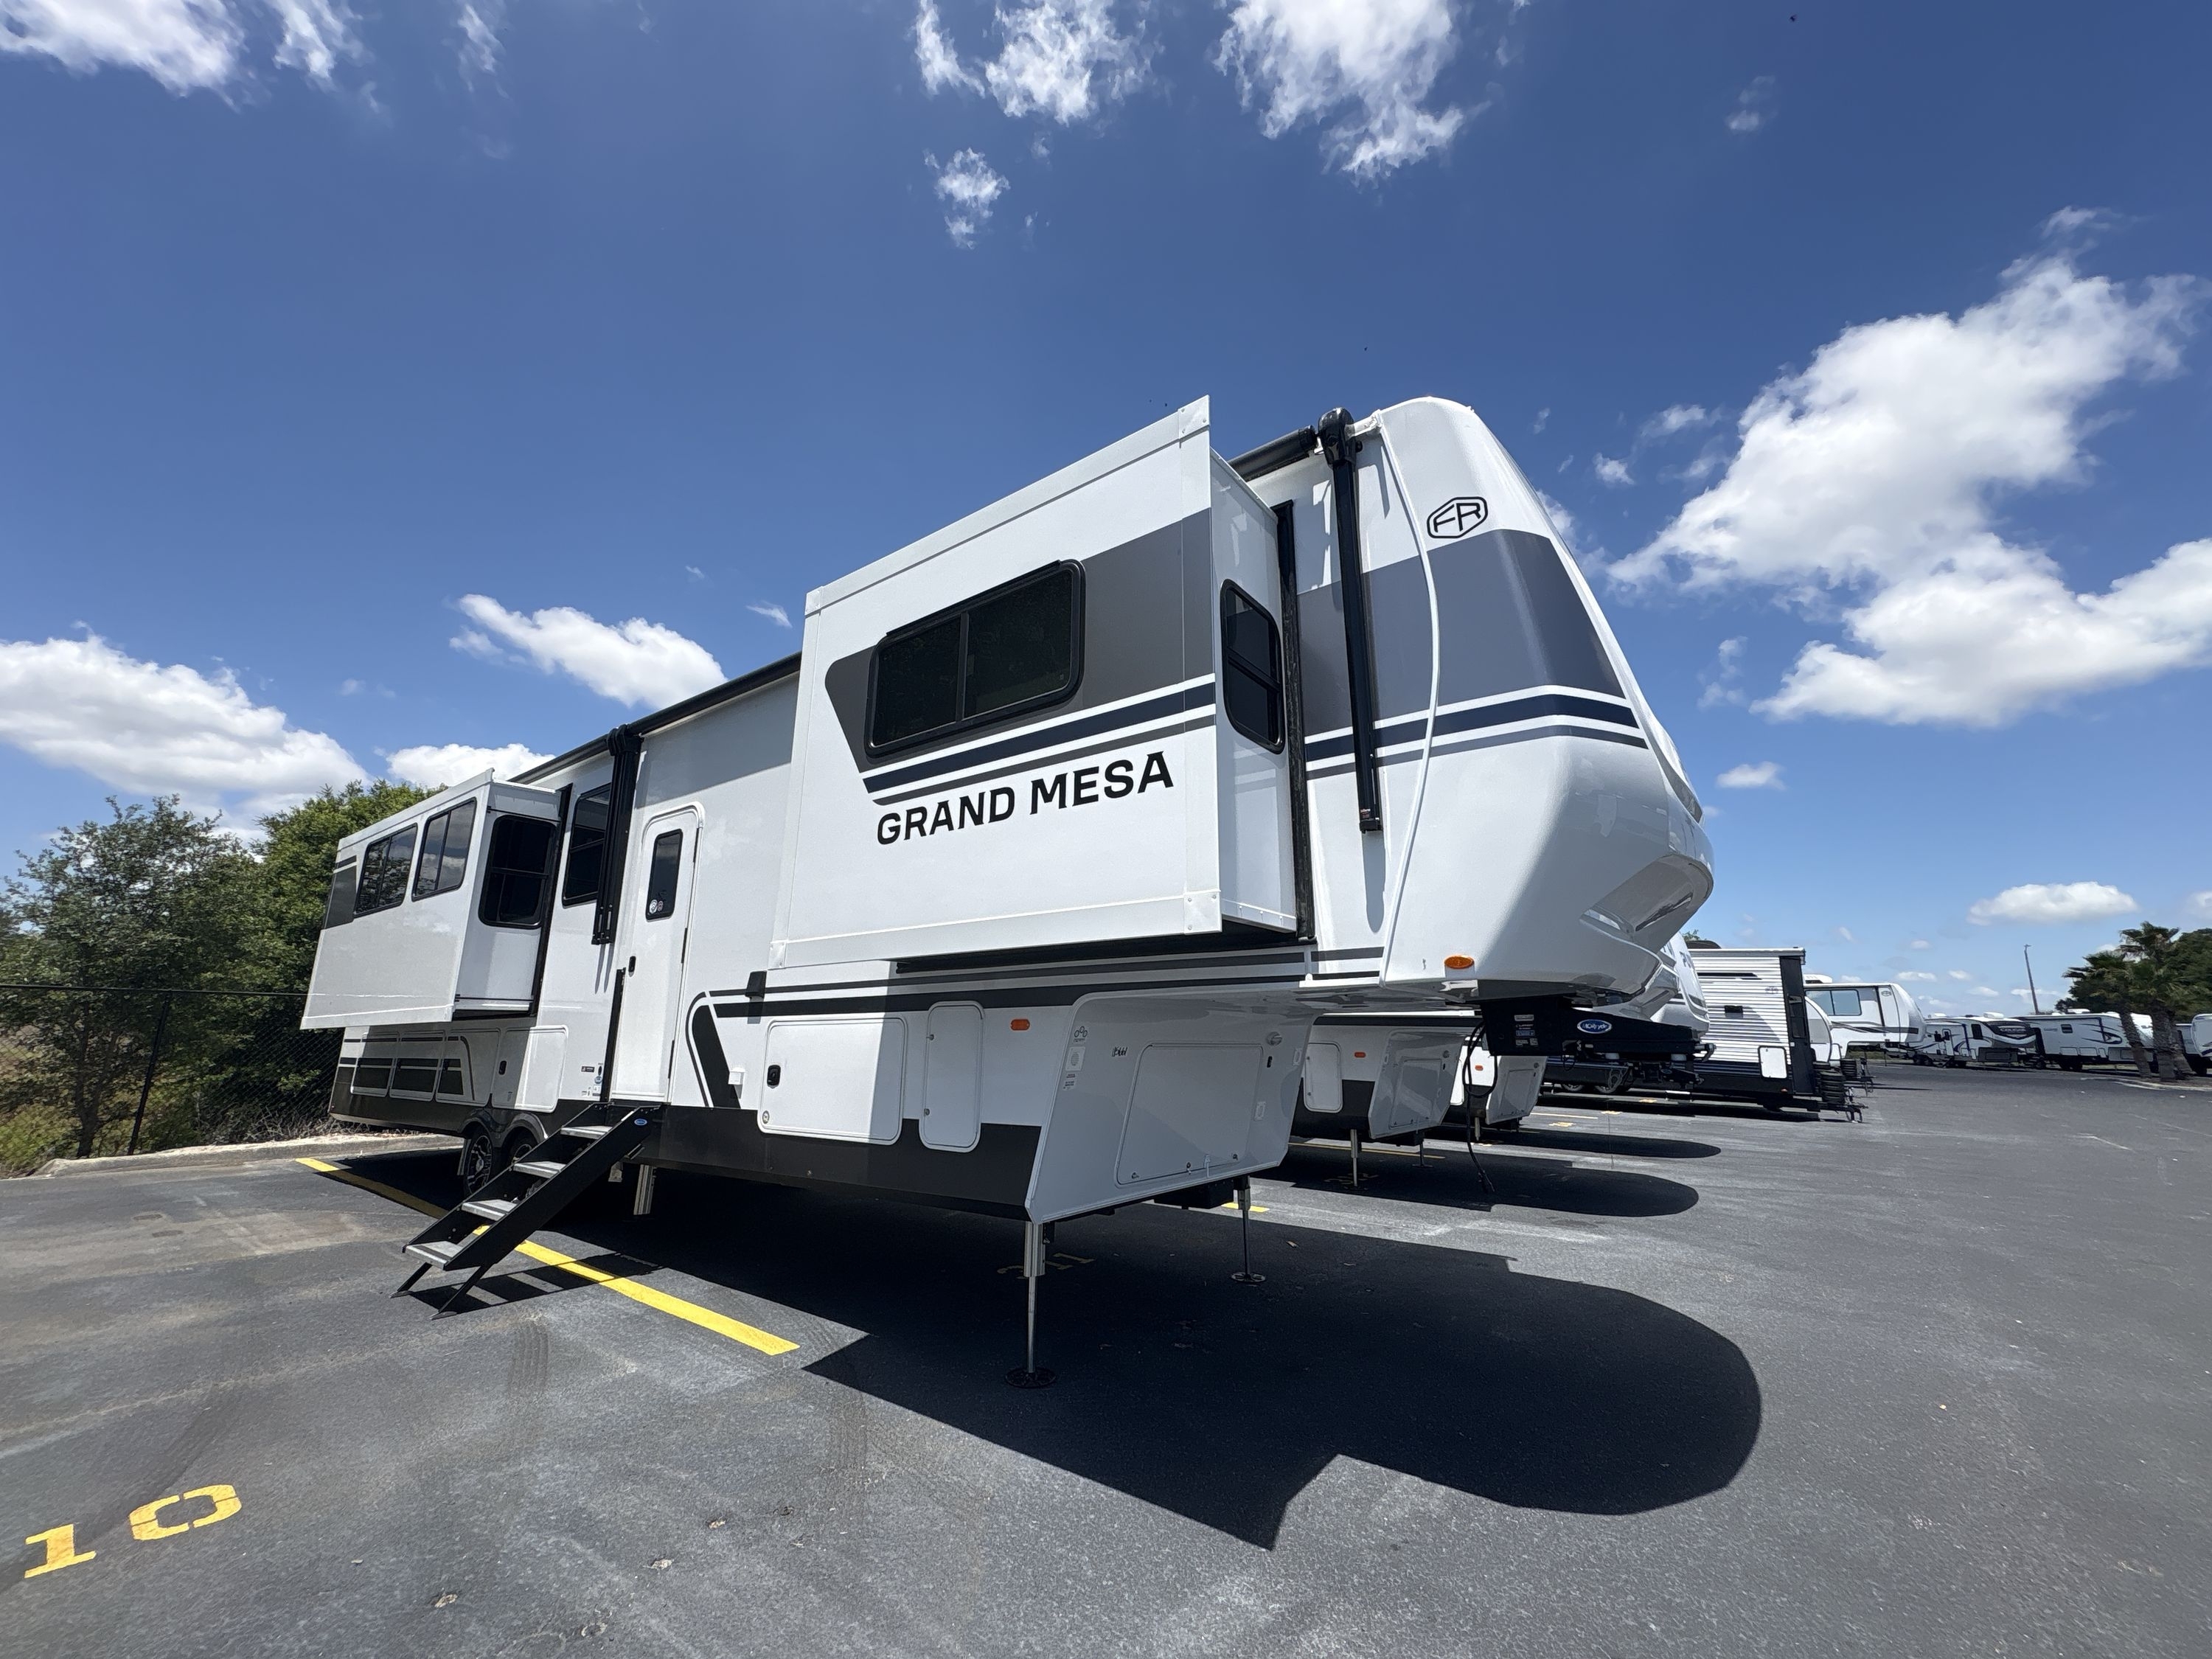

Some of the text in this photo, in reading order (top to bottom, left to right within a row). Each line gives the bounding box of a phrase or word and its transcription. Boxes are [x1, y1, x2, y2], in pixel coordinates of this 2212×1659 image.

[1433, 502, 1481, 533] FR
[877, 751, 1174, 845] GRAND MESA
[24, 1484, 242, 1579] 10
